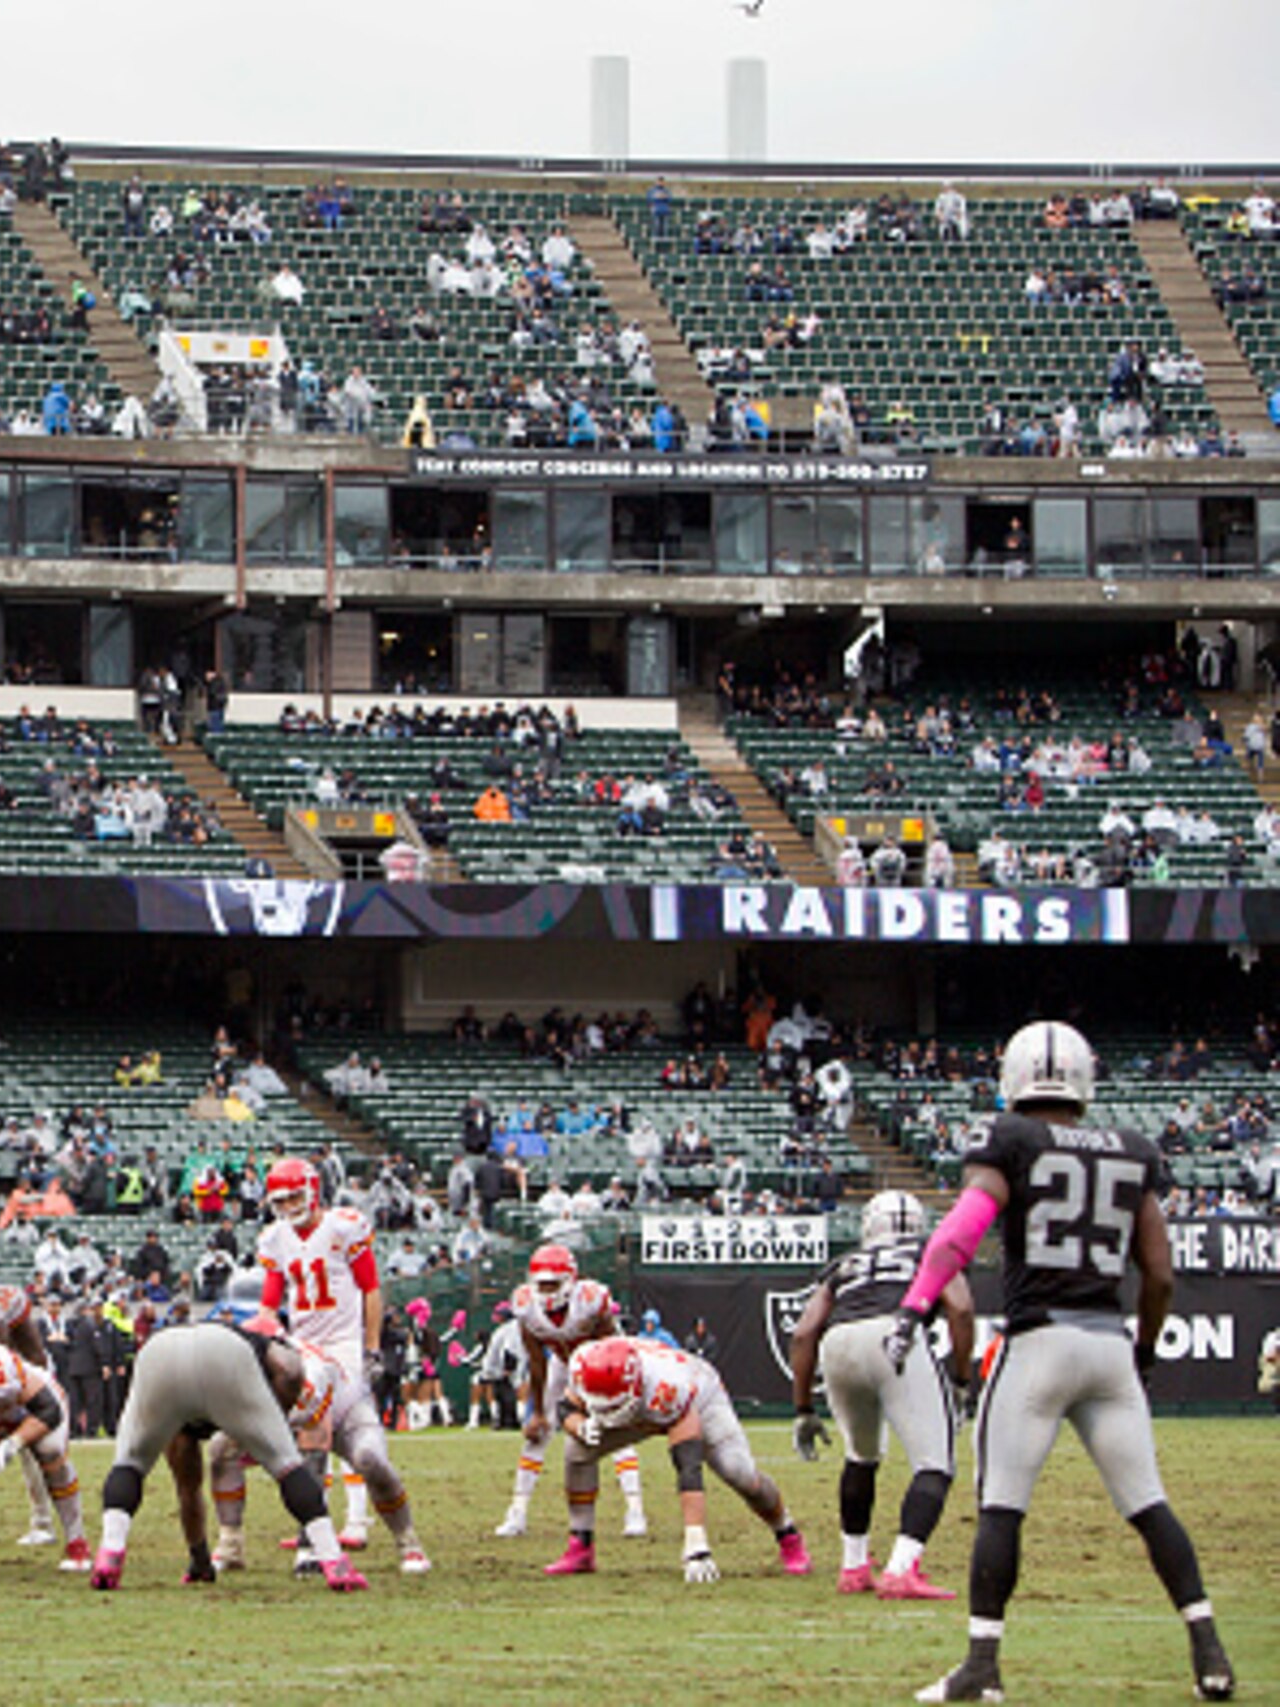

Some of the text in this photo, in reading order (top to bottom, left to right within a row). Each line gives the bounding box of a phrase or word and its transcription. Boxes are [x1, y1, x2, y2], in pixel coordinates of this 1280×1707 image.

[637, 461, 672, 476] AND
[677, 461, 760, 478] LOCATION
[767, 463, 789, 479] TO
[722, 886, 1071, 943] RAIDERS
[1024, 1151, 1147, 1277] 25
[288, 1257, 337, 1312] 11
